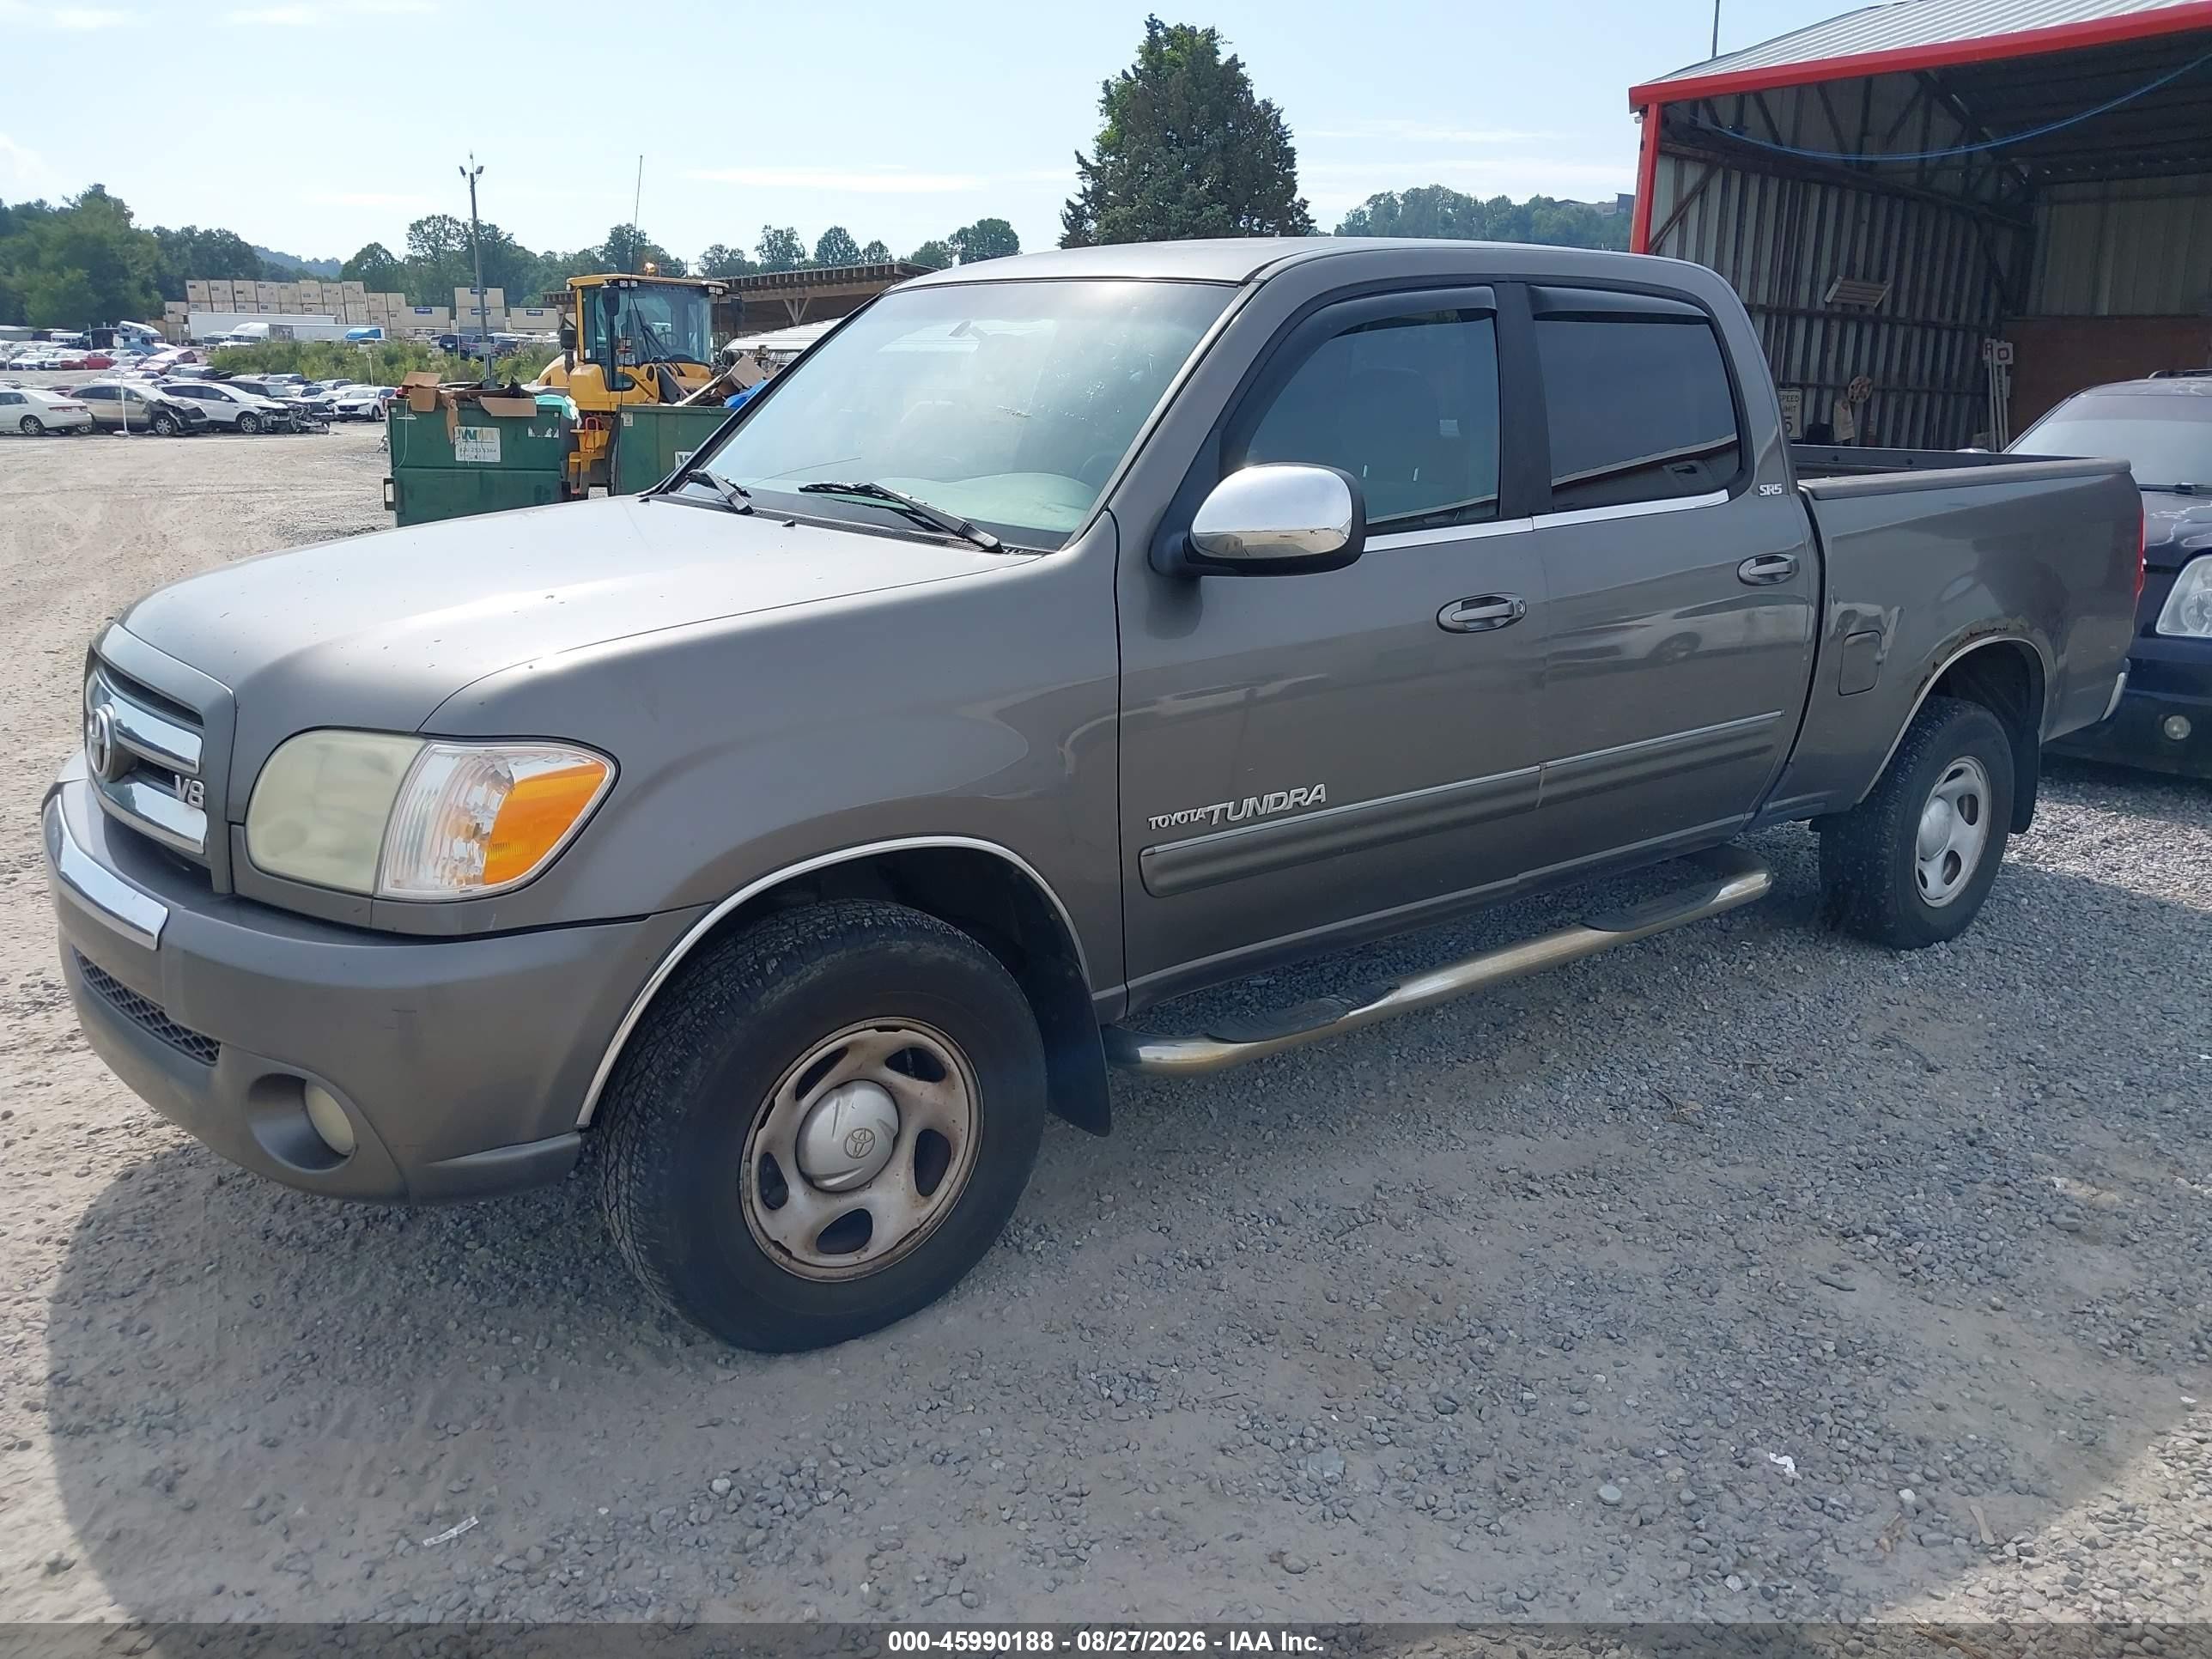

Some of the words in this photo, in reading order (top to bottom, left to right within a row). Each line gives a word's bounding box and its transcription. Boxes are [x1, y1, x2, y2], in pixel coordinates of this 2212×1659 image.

[1759, 483, 1783, 495] SR5
[174, 775, 204, 809] V8
[1148, 807, 1206, 830] TOYOTA
[1206, 783, 1327, 825] TUNDRA
